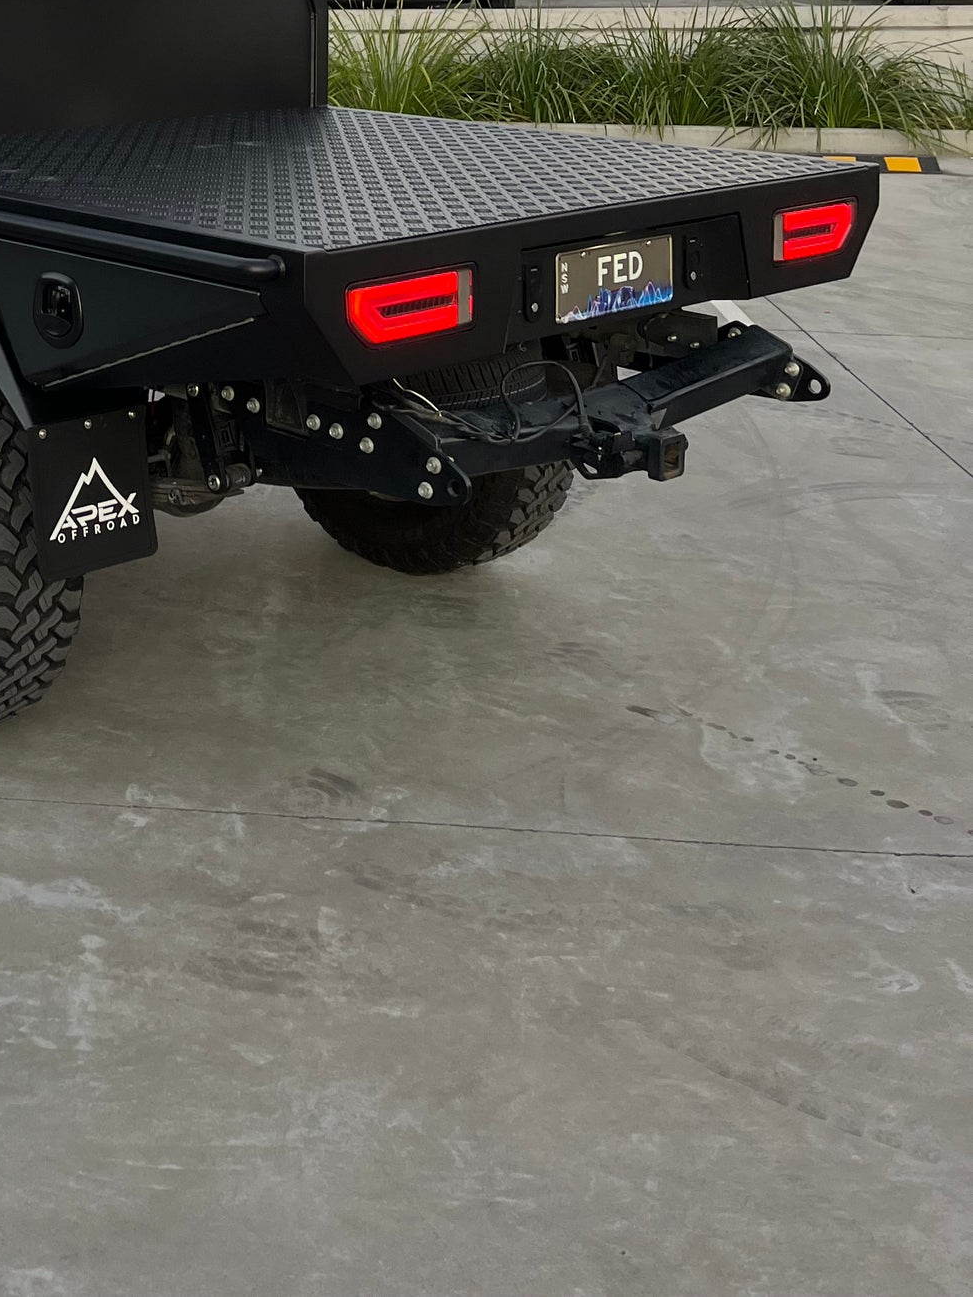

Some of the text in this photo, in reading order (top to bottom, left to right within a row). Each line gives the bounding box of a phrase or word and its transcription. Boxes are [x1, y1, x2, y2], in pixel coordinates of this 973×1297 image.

[560, 262, 569, 294] NSW
[597, 251, 643, 287] FED
[50, 492, 139, 541] APEX
[57, 514, 140, 543] OFFROAD
